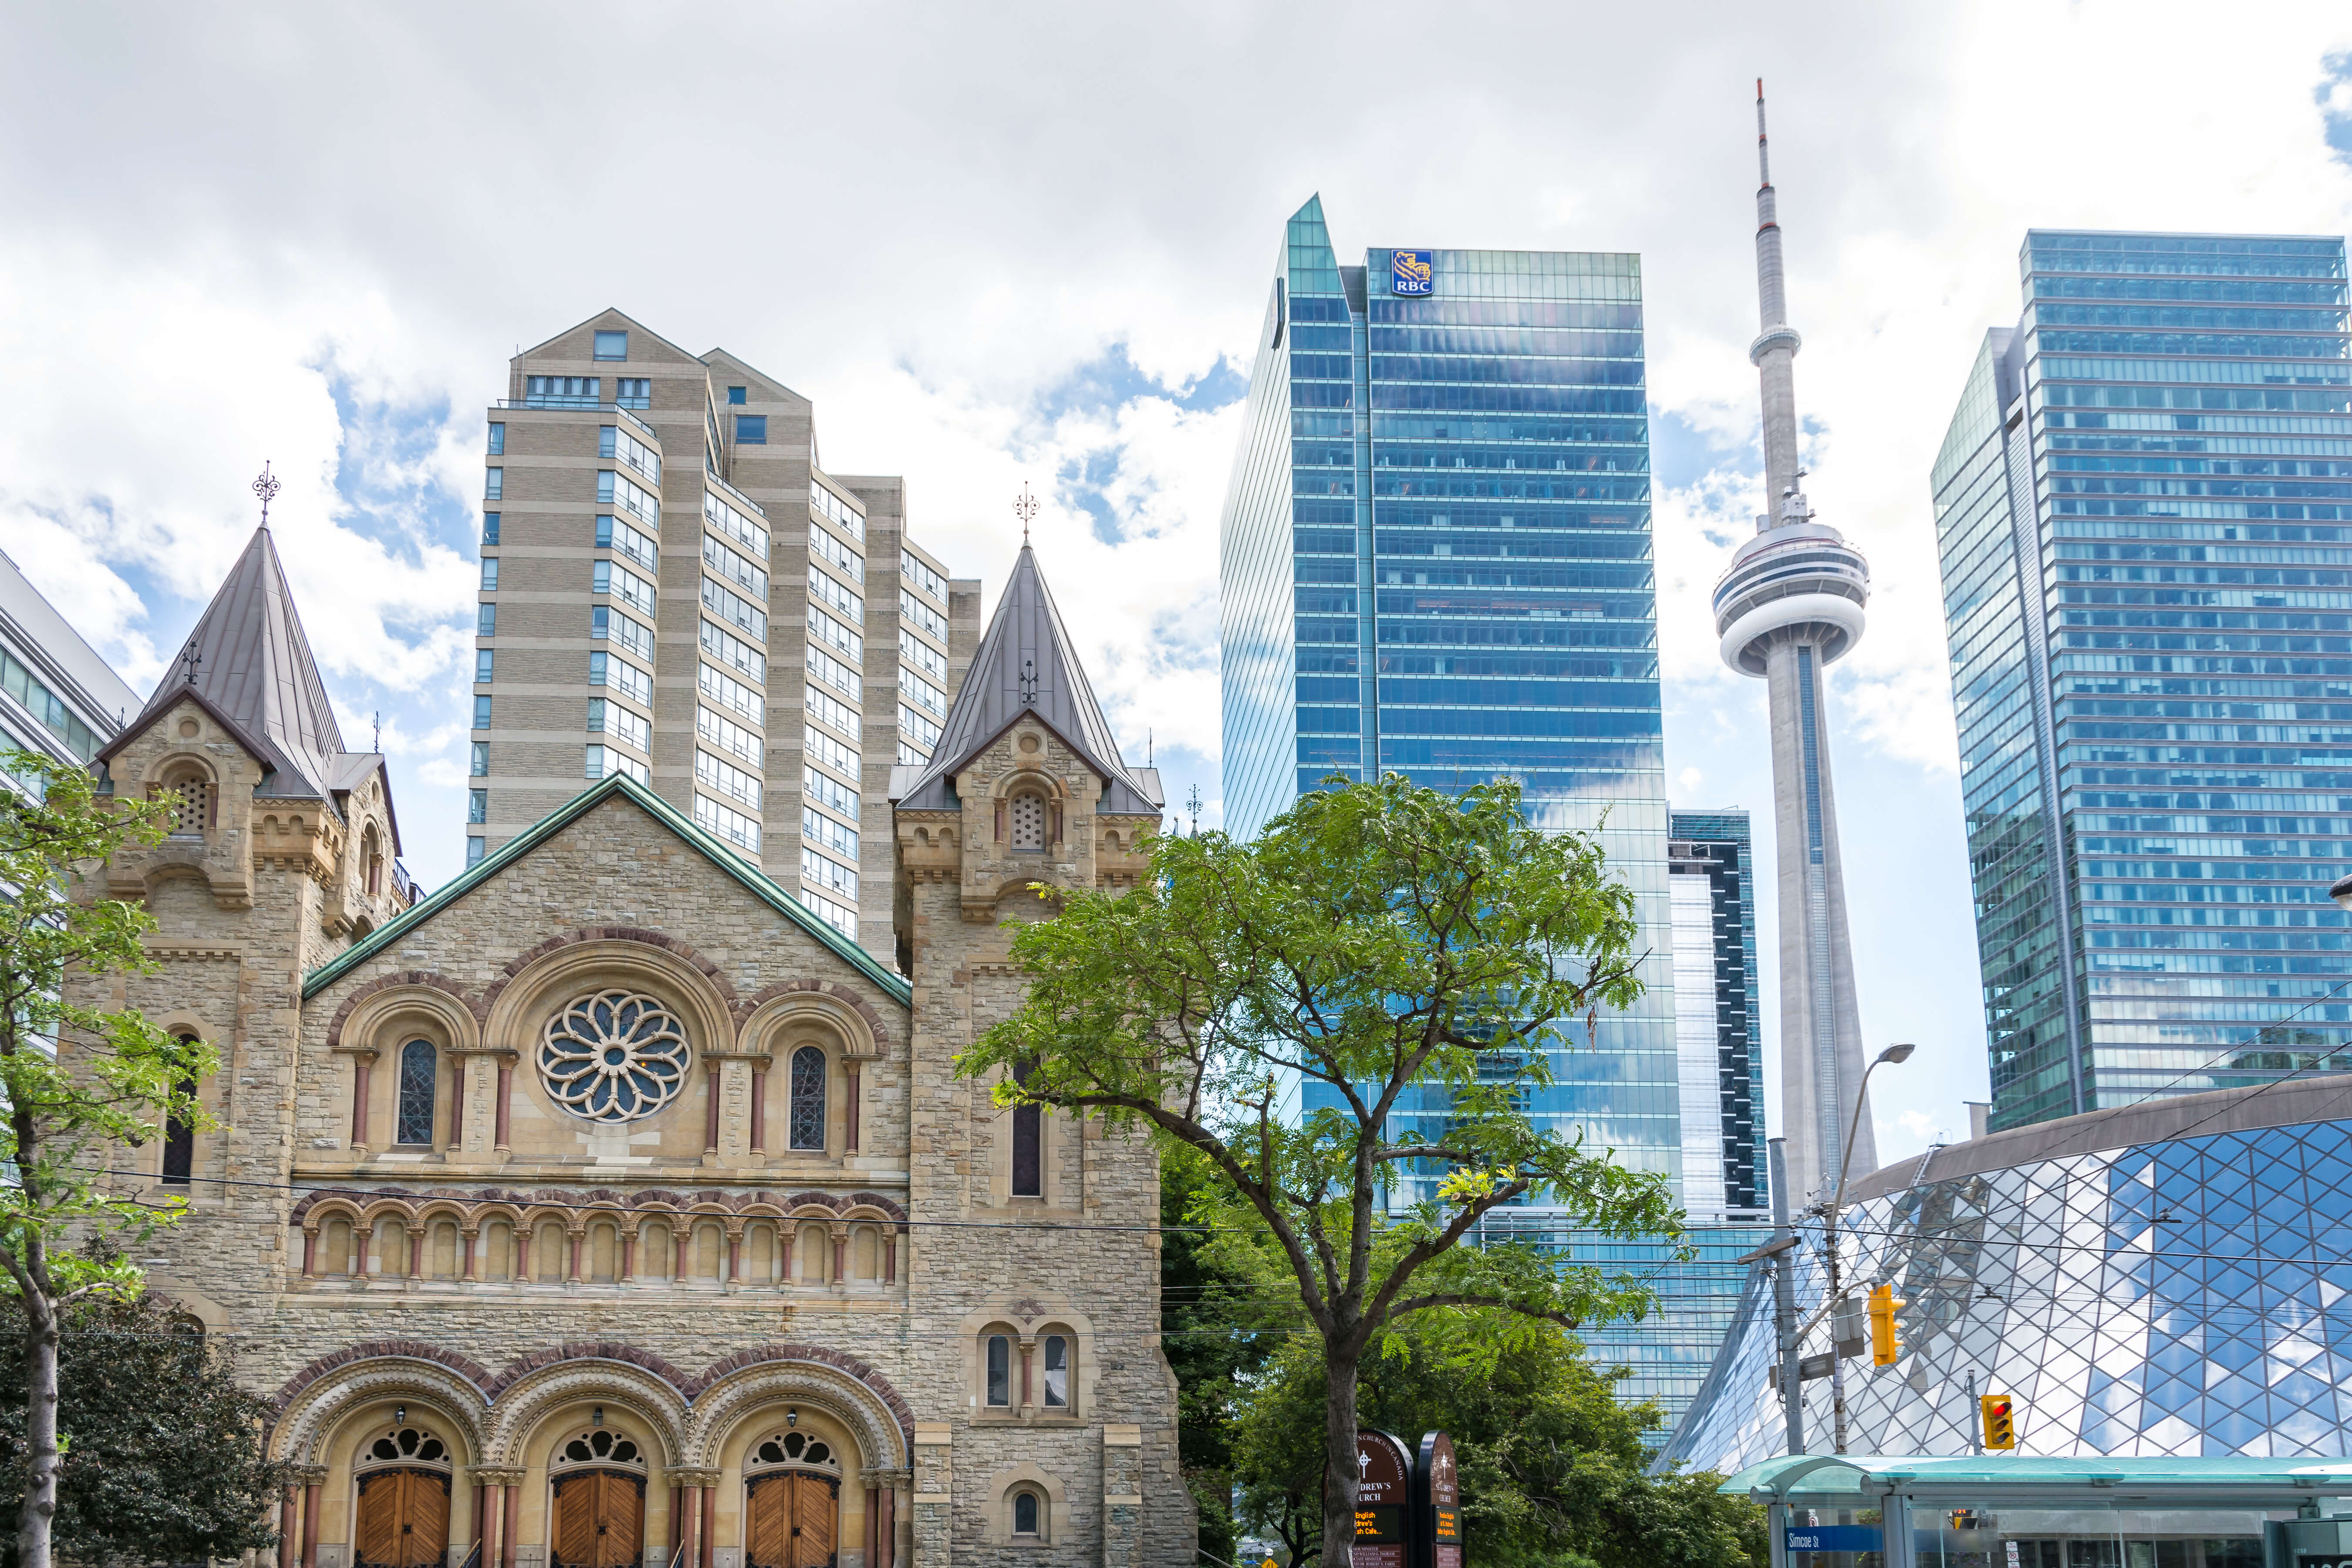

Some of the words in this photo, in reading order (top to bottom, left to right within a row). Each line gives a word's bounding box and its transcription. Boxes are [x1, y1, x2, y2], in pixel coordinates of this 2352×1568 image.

[1397, 281, 1429, 291] RBC
[1363, 1435, 1387, 1447] CHURCH
[1386, 1445, 1394, 1453] IN
[1391, 1452, 1404, 1480] CANADA
[1360, 1482, 1390, 1491] DREW'S
[1359, 1493, 1381, 1501] URCH
[1789, 1533, 1812, 1548] Simcoe
[1813, 1535, 1819, 1548] St
